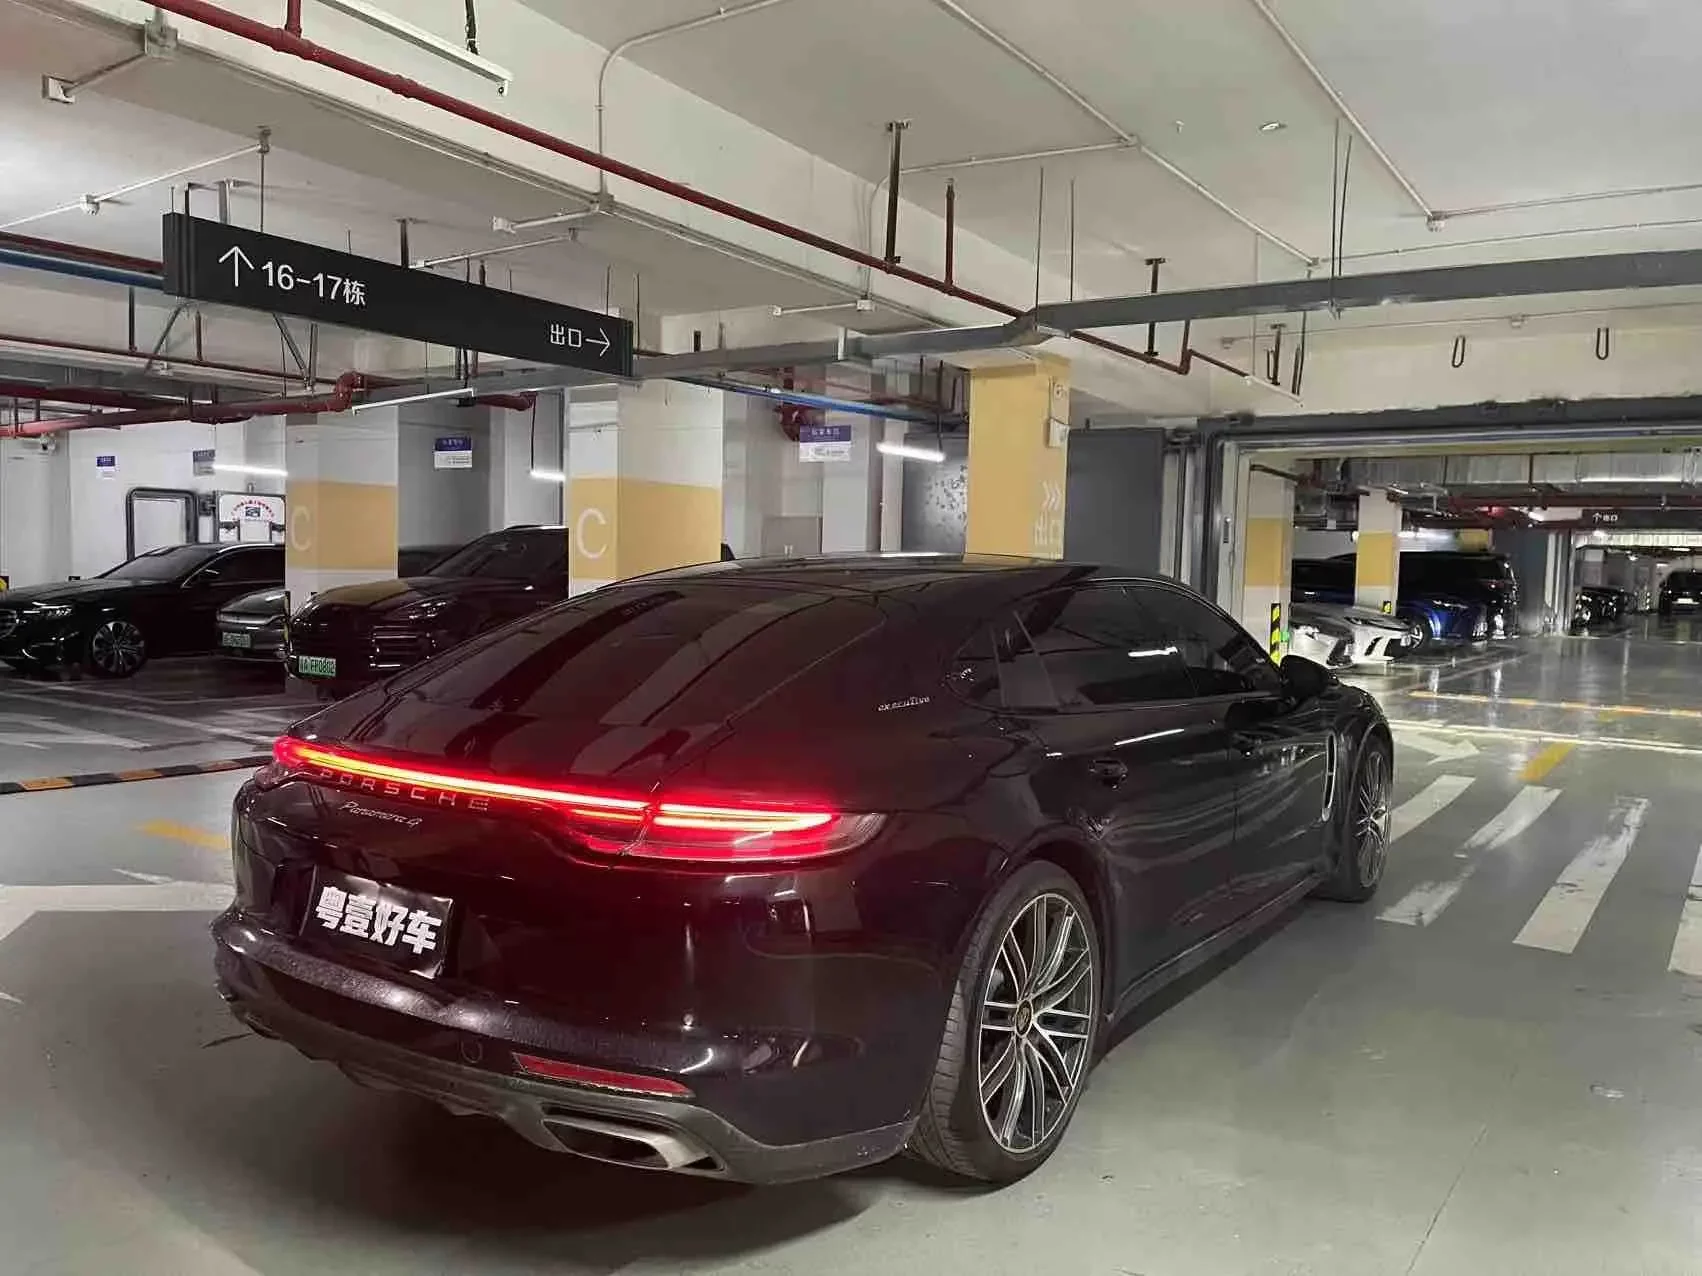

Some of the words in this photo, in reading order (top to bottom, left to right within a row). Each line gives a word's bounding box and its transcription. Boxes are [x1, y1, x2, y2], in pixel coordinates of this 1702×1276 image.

[262, 260, 366, 306] 16-17栋
[550, 323, 582, 348] 出口
[291, 505, 312, 552] C
[577, 507, 607, 559] C
[319, 767, 490, 811] PORSCHE
[315, 886, 443, 955] 粤壹好车
